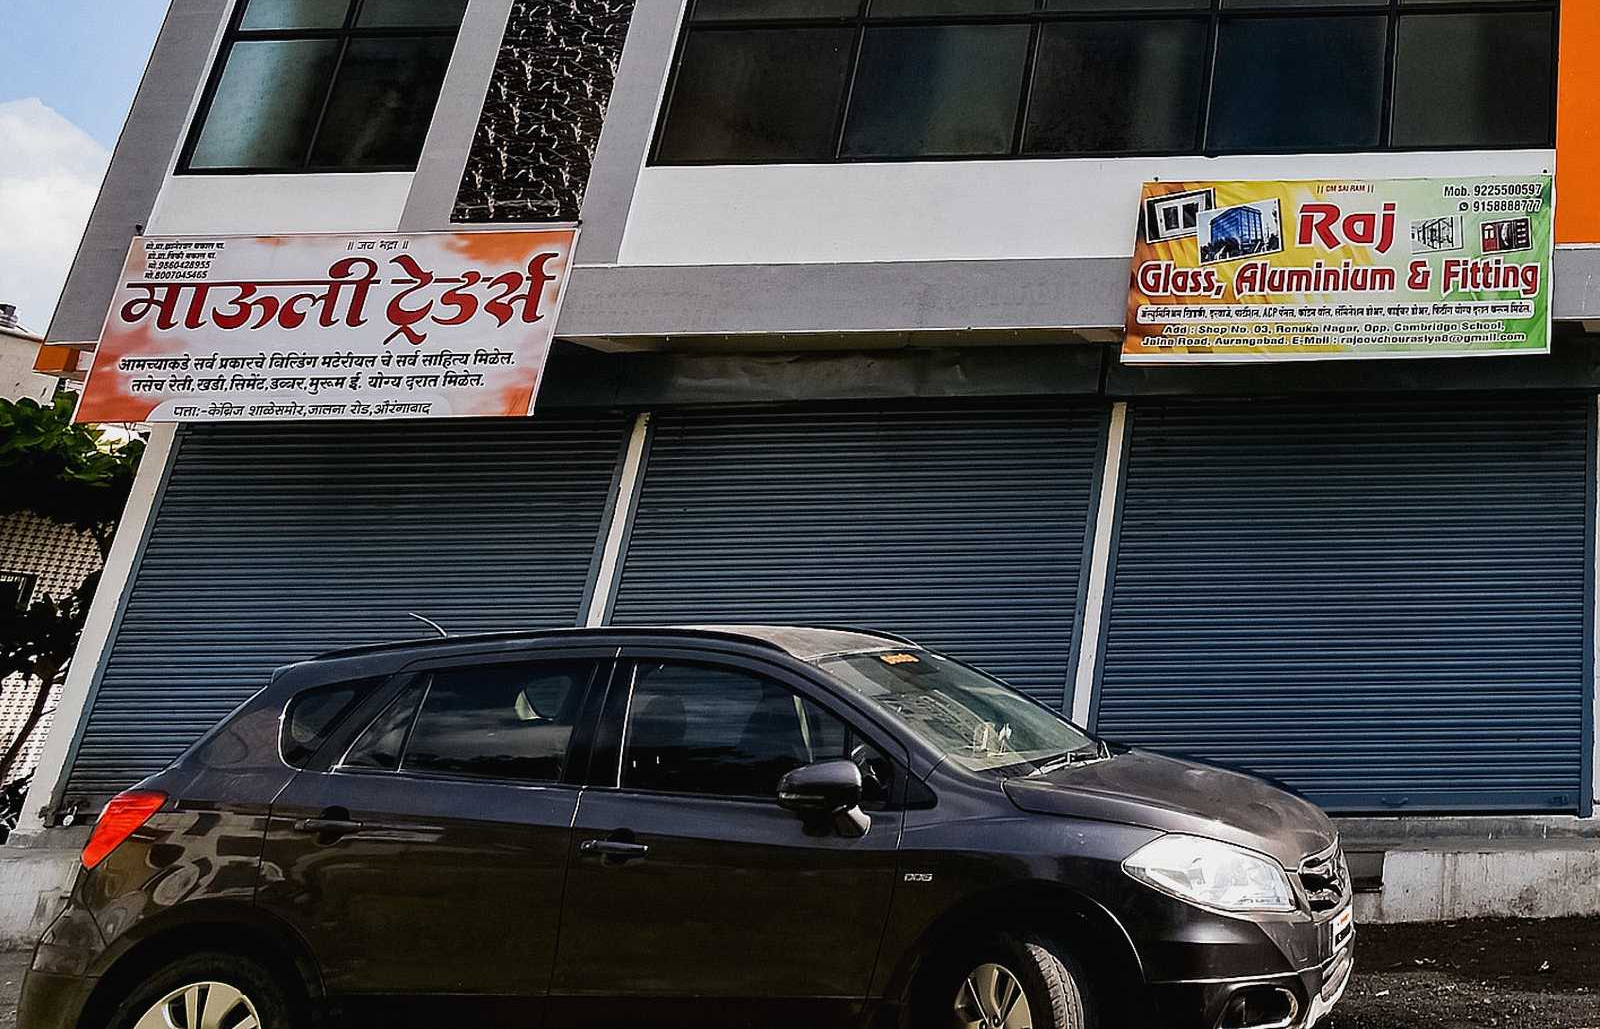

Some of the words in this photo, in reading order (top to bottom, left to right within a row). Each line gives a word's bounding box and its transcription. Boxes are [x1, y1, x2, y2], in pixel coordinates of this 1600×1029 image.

[1444, 185, 1470, 197] Mob.
[1474, 184, 1541, 196] 9225500597
[1473, 200, 1541, 212] 9158888777
[1298, 203, 1396, 253] Raj
[357, 242, 376, 250] जय
[1140, 263, 1223, 296] Glass,
[1235, 262, 1395, 296] Aluminium
[1408, 260, 1431, 290] &
[1443, 259, 1539, 295] Fitting
[120, 256, 381, 330] माऊली
[383, 252, 559, 346] ट्रेडर्स
[1262, 309, 1278, 318] ACP
[1165, 326, 1187, 334] Add
[1198, 325, 1228, 335] Shop
[1231, 325, 1249, 334] No.
[1364, 324, 1390, 334] Opp.
[1292, 335, 1330, 345] E-Mail
[118, 353, 191, 371] आमच्याकडे
[193, 353, 218, 371] सर्व
[218, 352, 267, 370] प्रकारचे
[381, 350, 394, 368] चे
[396, 350, 420, 367] सर्व
[422, 349, 470, 369] साहित्य
[473, 348, 515, 365] मिळेल.
[131, 375, 166, 392] तसेच
[368, 372, 403, 389] योग्य
[405, 374, 440, 391] दरात
[442, 371, 484, 387] मिळेल.
